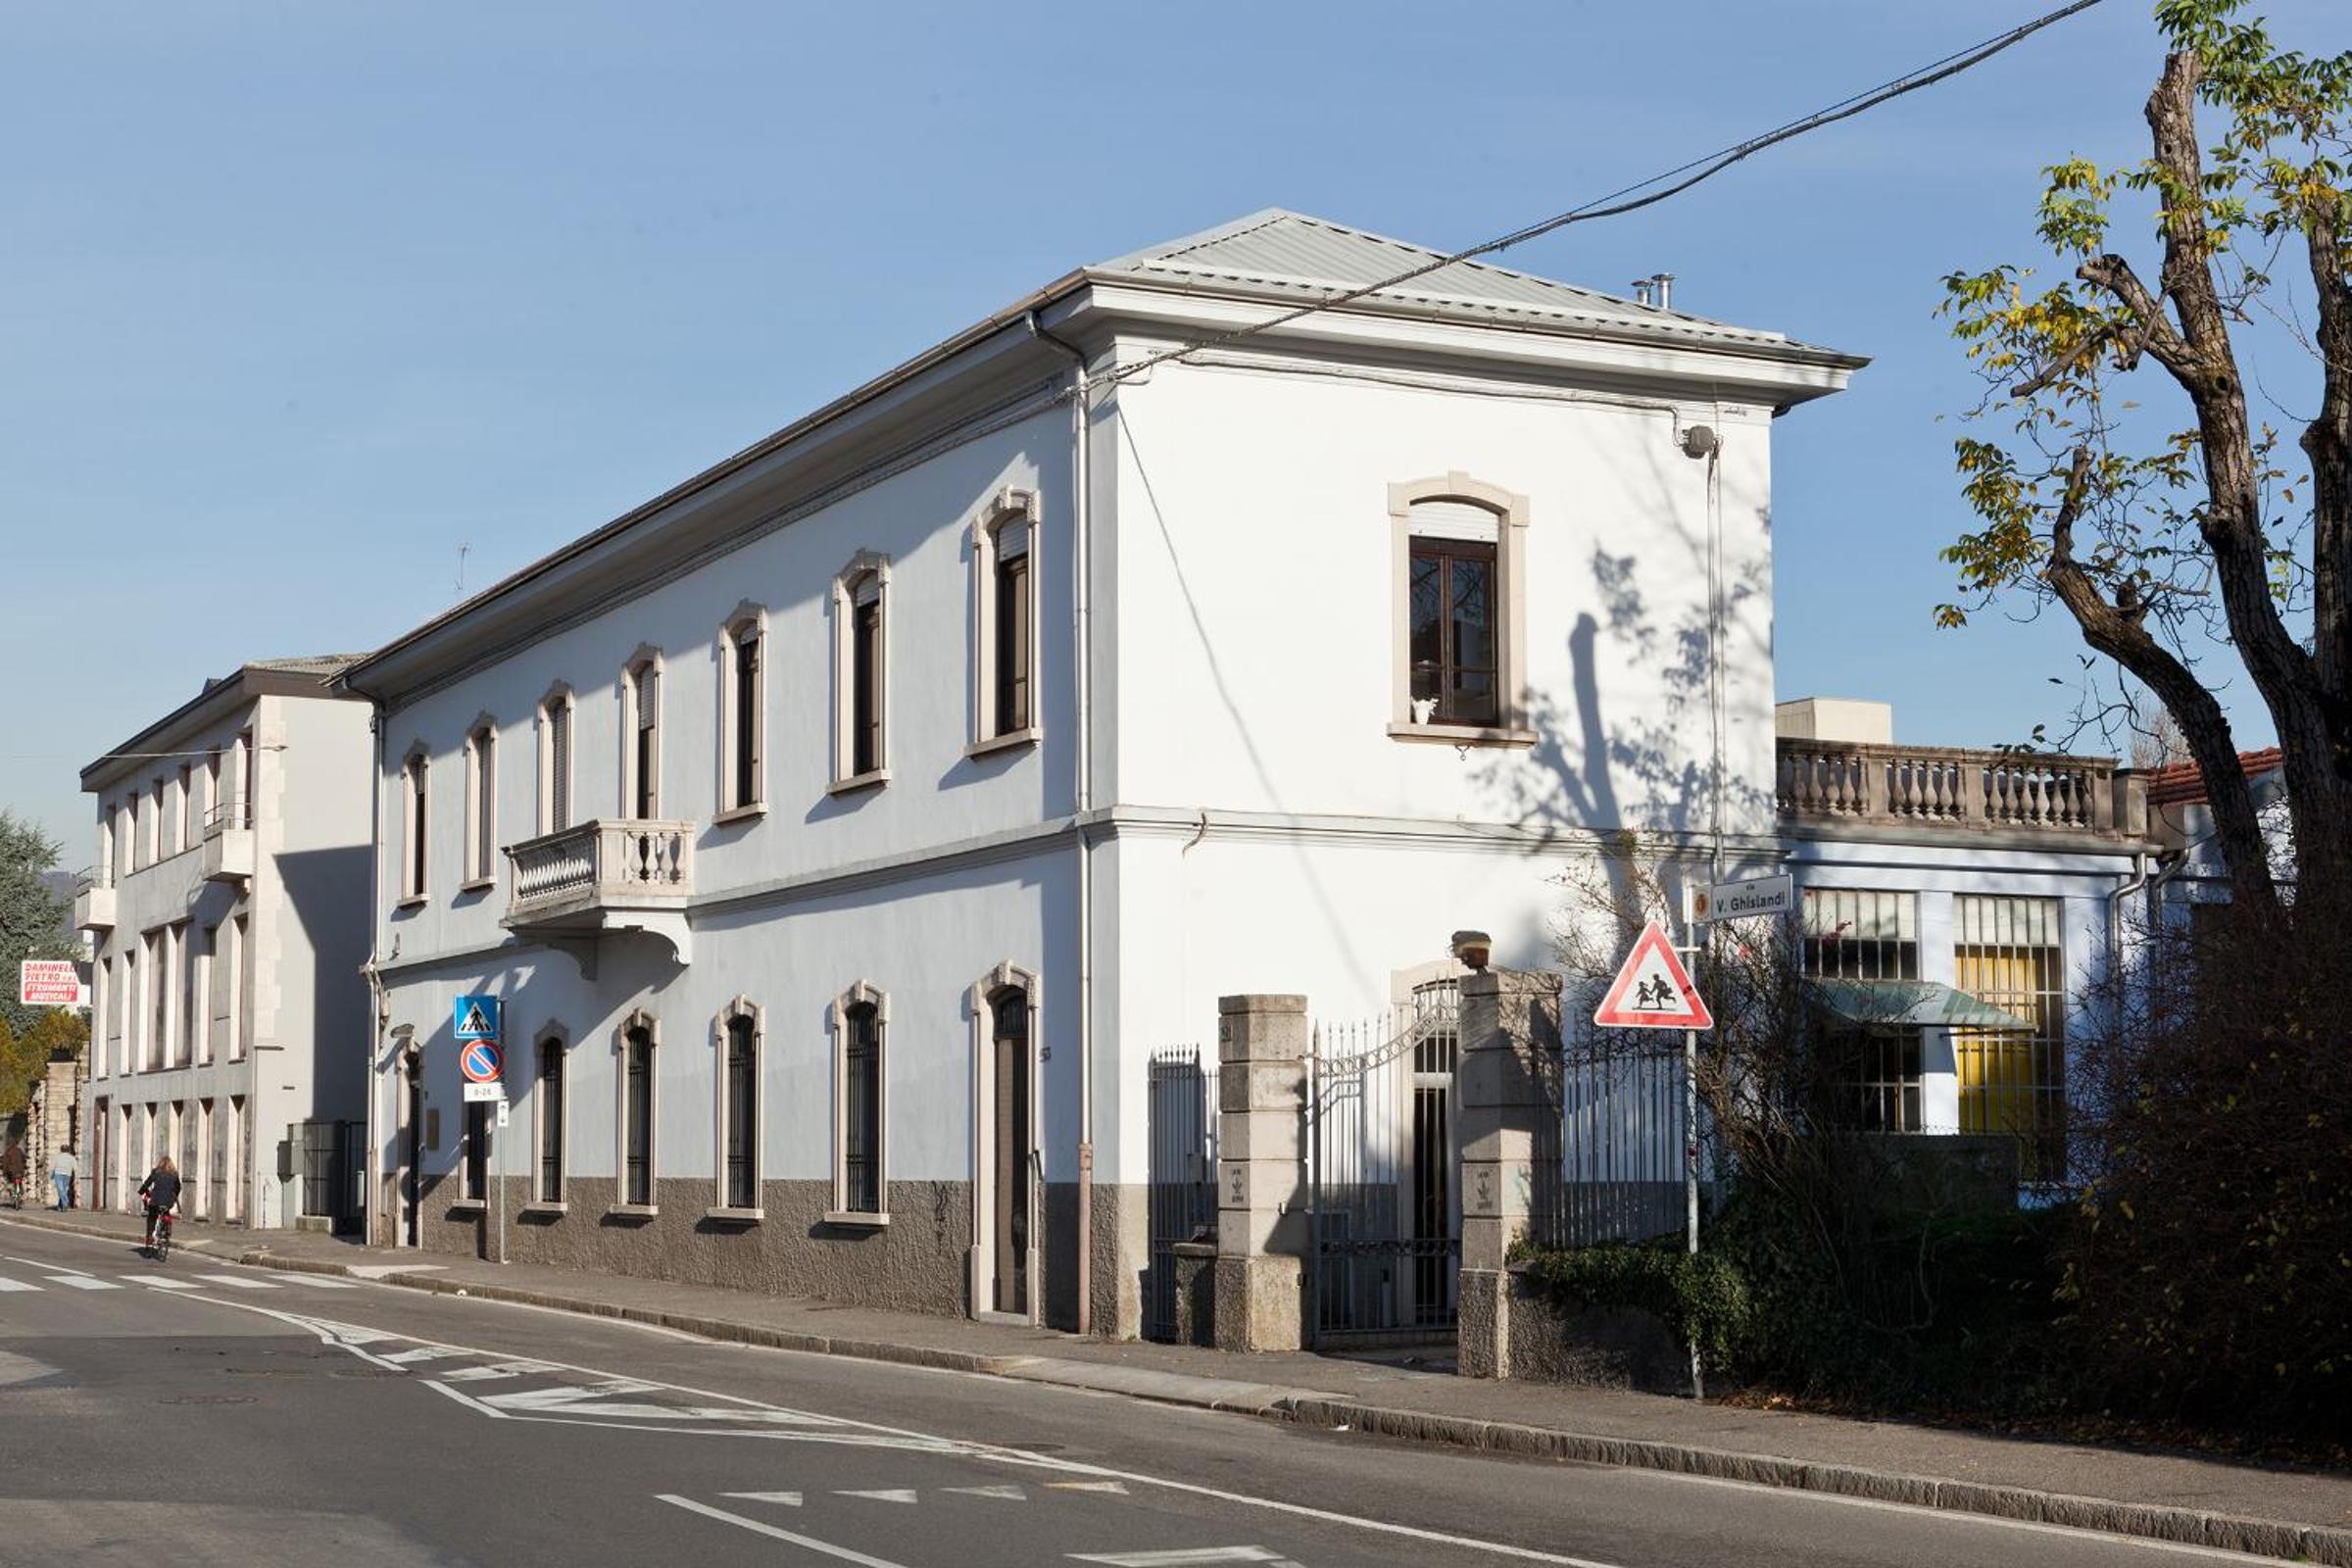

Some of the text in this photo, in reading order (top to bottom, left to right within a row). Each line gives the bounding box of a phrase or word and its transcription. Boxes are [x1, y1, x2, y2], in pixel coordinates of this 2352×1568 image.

[1717, 891, 1786, 912] V. Ghislandi
[24, 972, 61, 981] PIETRO
[26, 983, 77, 992] STRUMENTI
[31, 992, 74, 1001] MUSICALI
